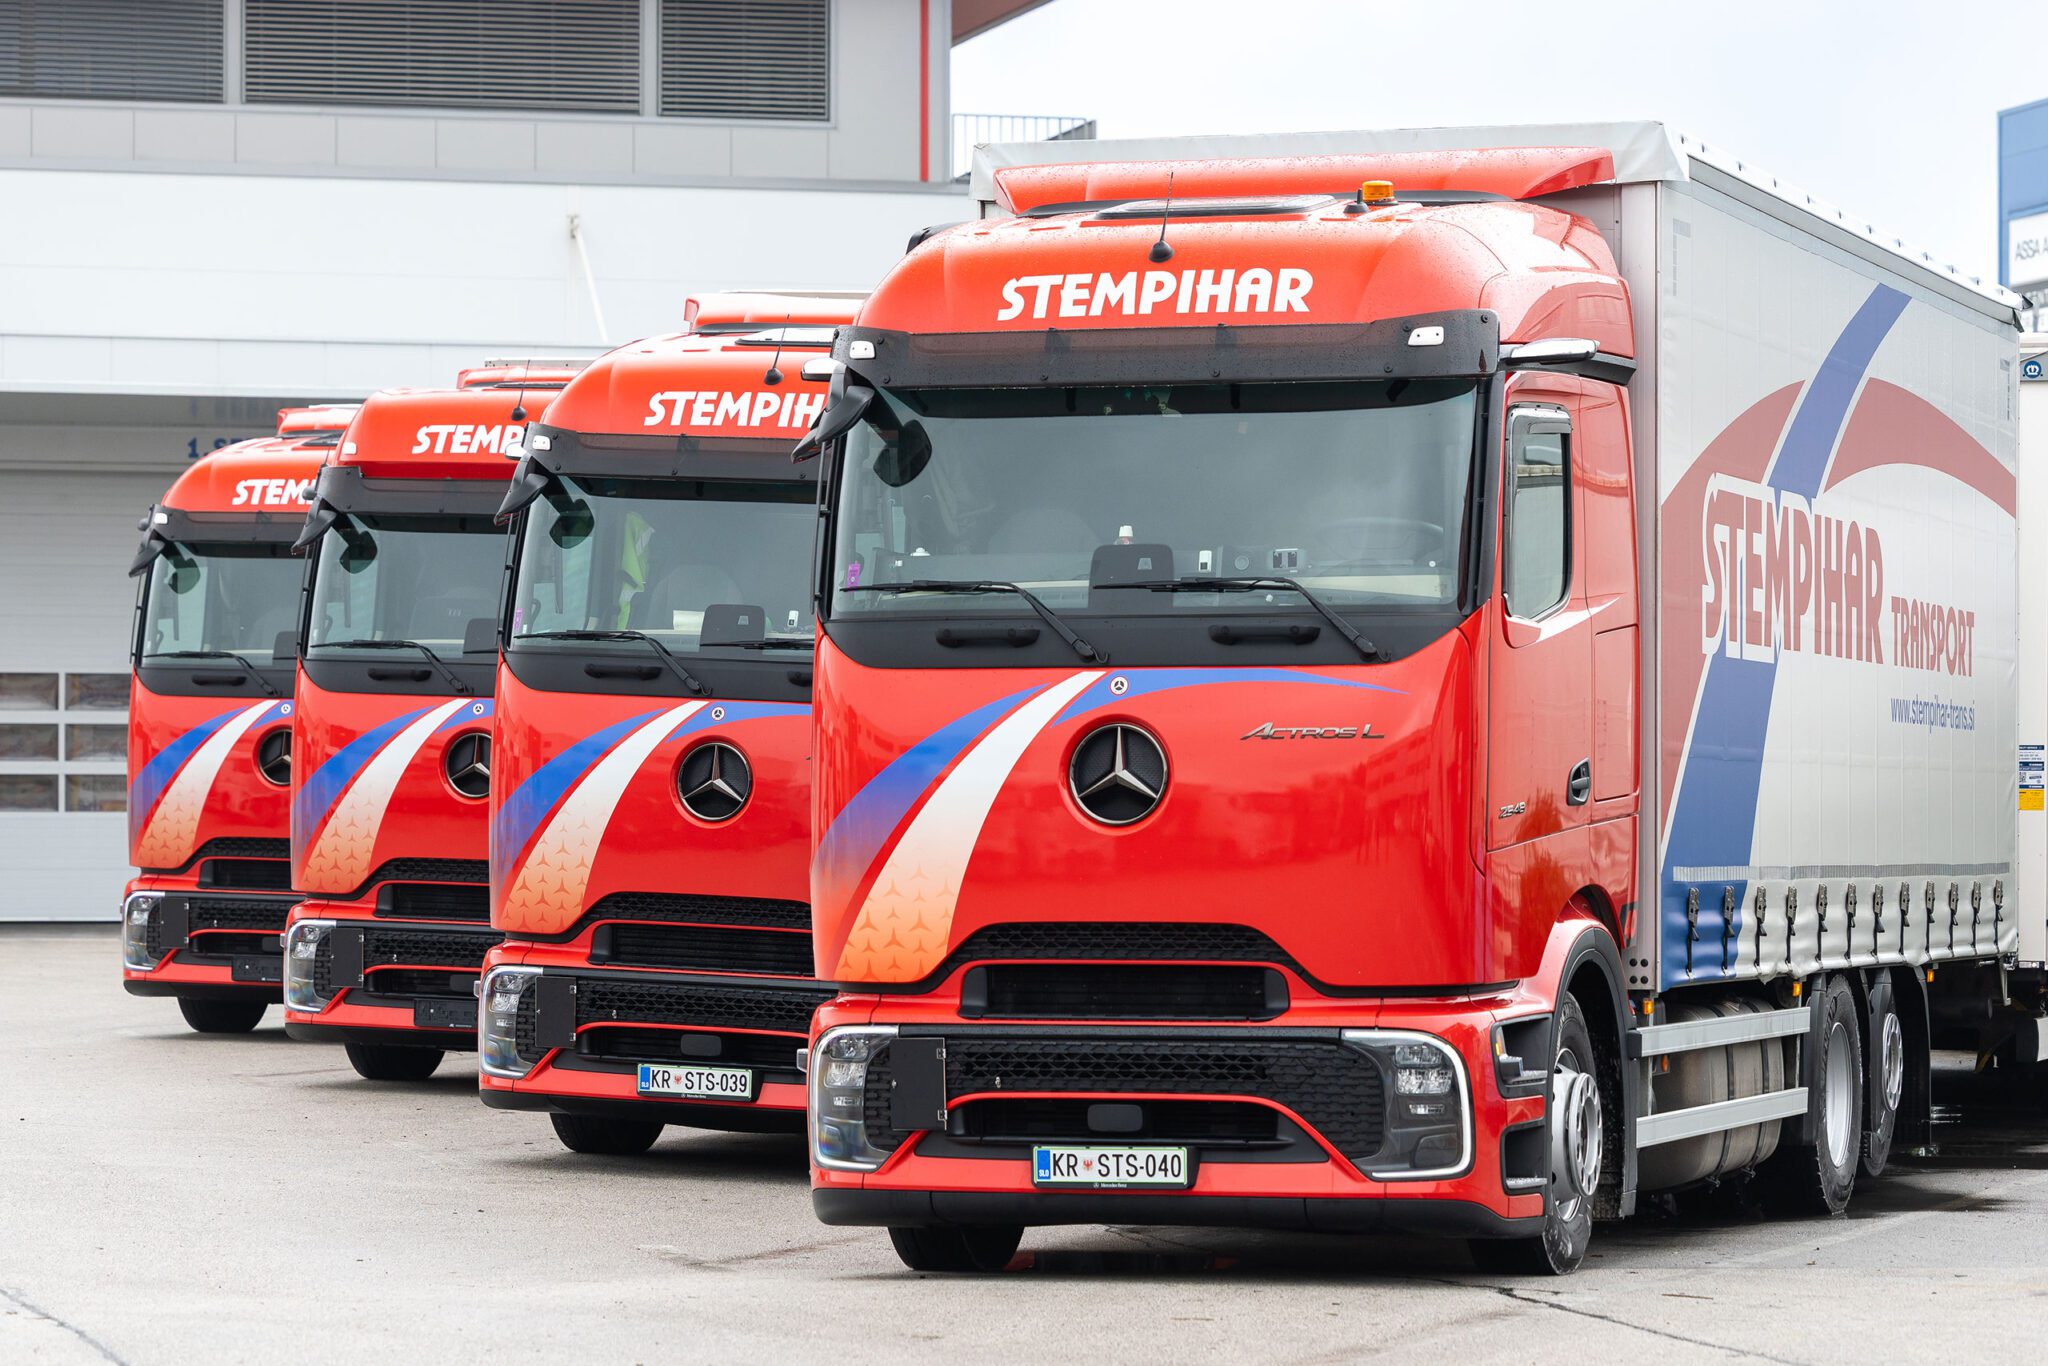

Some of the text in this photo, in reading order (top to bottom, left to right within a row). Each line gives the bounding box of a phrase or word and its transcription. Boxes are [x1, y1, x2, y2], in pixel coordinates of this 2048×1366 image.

[2015, 239, 2040, 260] ASSA
[997, 268, 1314, 321] STEMPIHAR
[1704, 487, 1975, 677] STEMPIHAR TRANSPORT
[1890, 694, 1975, 733] www.stempihar-trans.si
[1361, 723, 1385, 739] L
[652, 1069, 671, 1089] KR
[685, 1071, 748, 1093] STS-039
[1052, 1152, 1078, 1177] KR
[1098, 1153, 1182, 1178] STS-040
